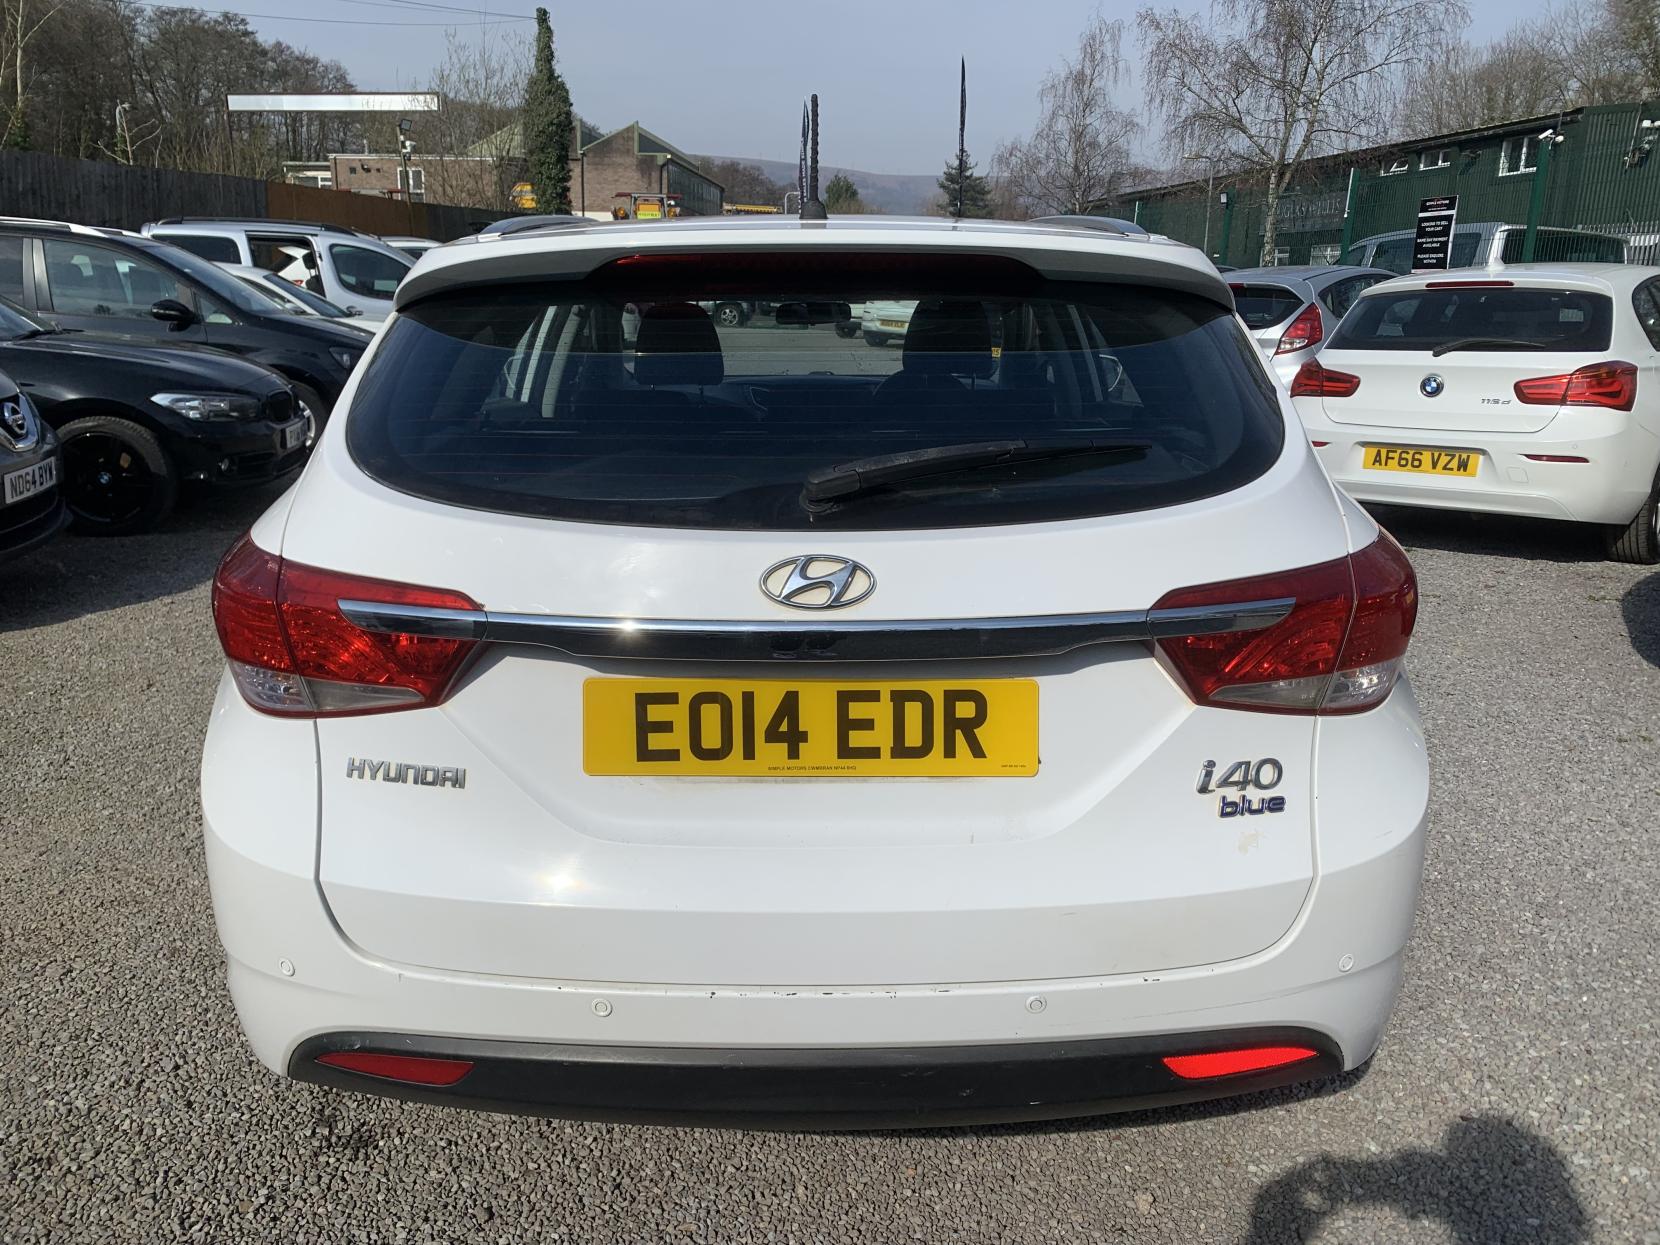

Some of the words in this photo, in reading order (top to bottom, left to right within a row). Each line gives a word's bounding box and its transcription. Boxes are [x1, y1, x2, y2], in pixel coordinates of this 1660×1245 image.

[1372, 449, 1422, 468] AF66
[1430, 452, 1470, 472] VZW
[10, 468, 36, 499] ND64
[38, 460, 54, 486] BYW
[634, 690, 808, 762] EO14
[836, 690, 988, 760] EDR
[346, 756, 466, 789] HYUNDAI
[1196, 758, 1284, 794] i40
[1218, 794, 1286, 818] blue
